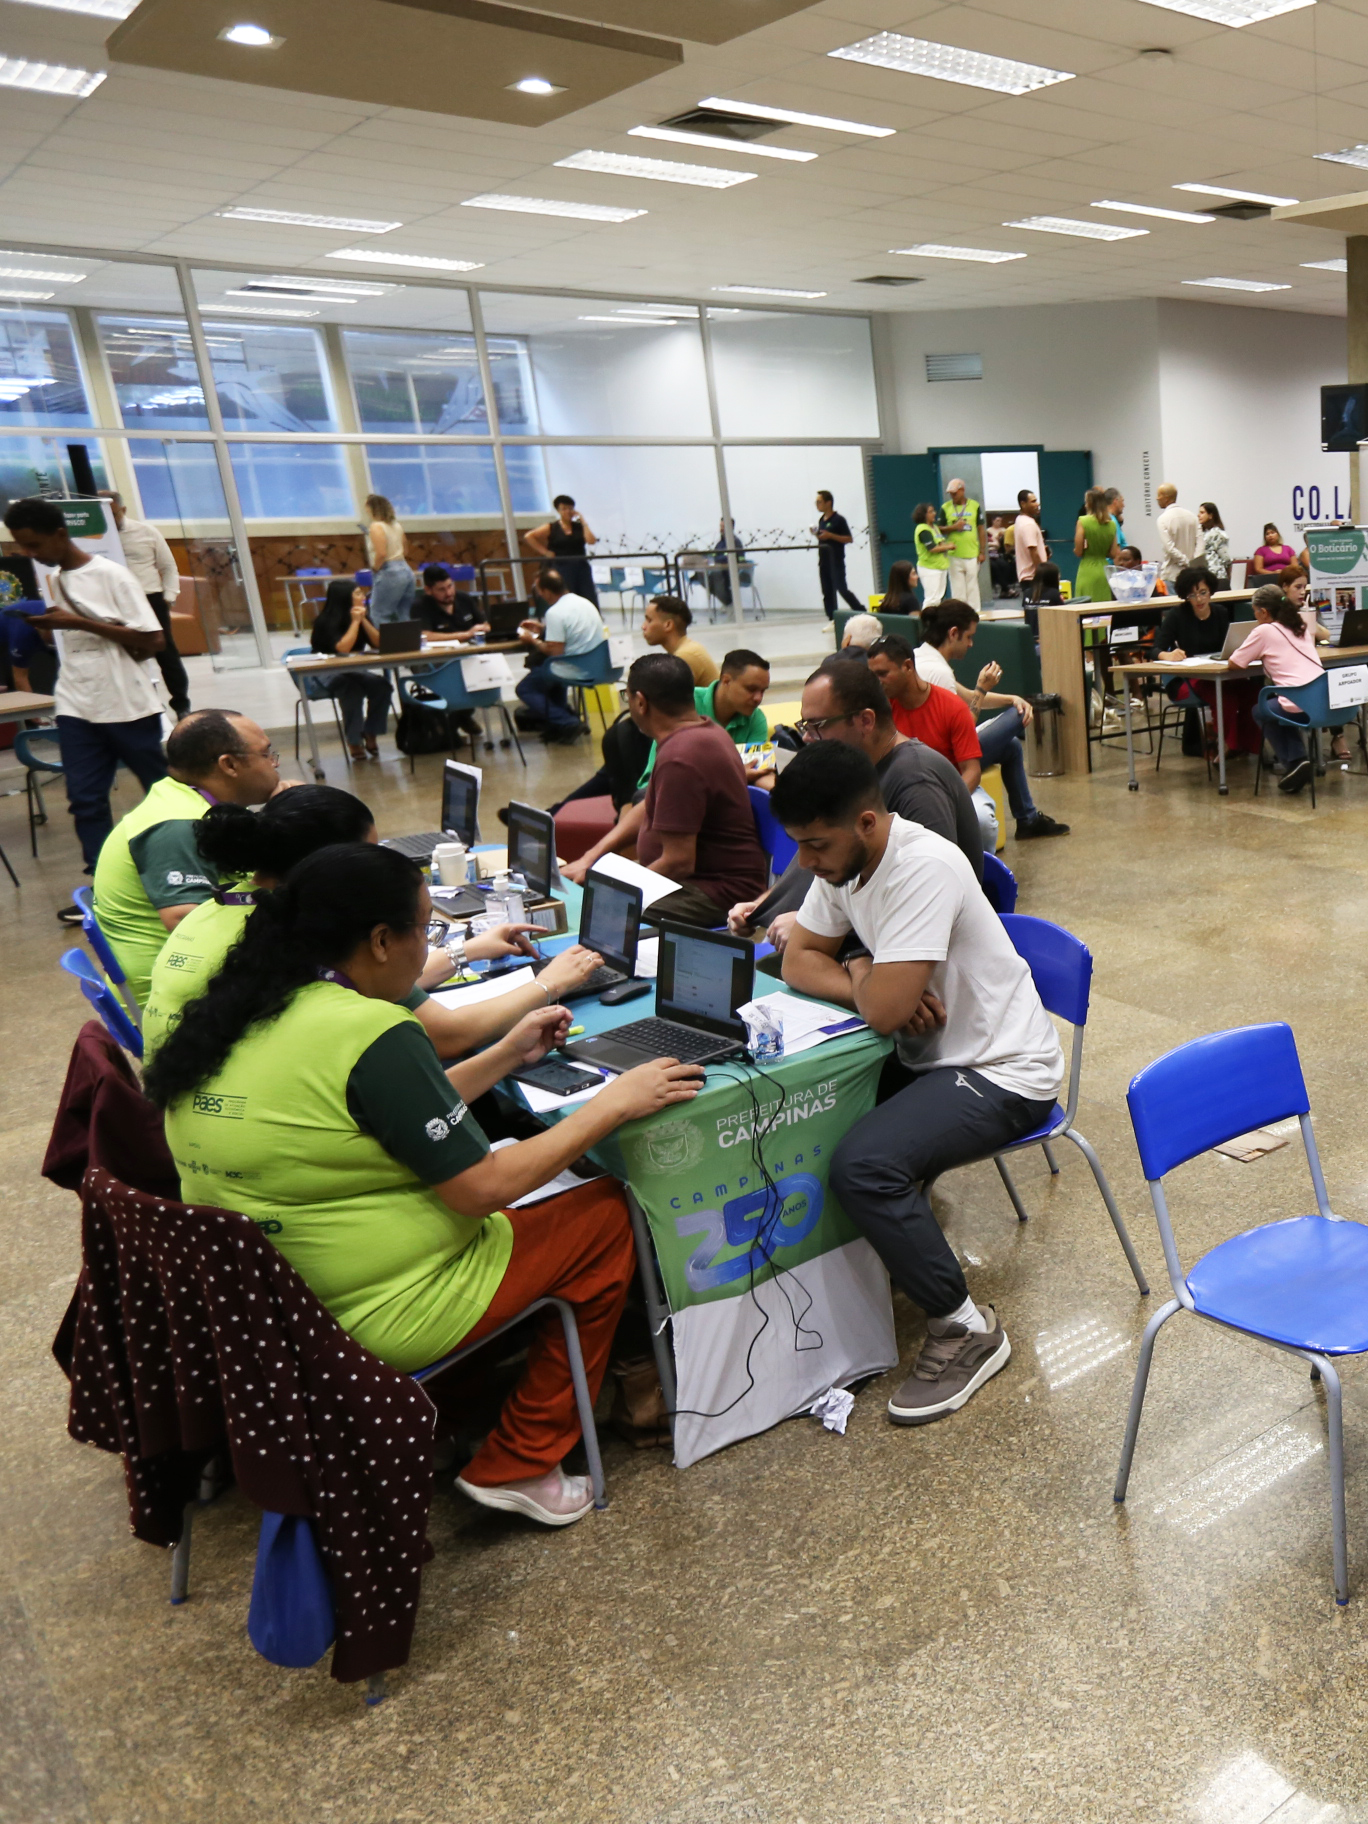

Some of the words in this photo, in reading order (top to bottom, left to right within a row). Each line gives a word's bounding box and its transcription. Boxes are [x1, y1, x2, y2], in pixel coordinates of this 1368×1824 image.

[1310, 545, 1316, 553] O
[1318, 543, 1357, 553] Boticário
[716, 1089, 814, 1131] PREFEITURA
[818, 1079, 838, 1096] DE
[718, 1093, 836, 1148] CAMPINAS
[670, 1145, 821, 1209] CAMPINAS
[674, 1172, 825, 1293] 250
[782, 1200, 807, 1218] ANOS
